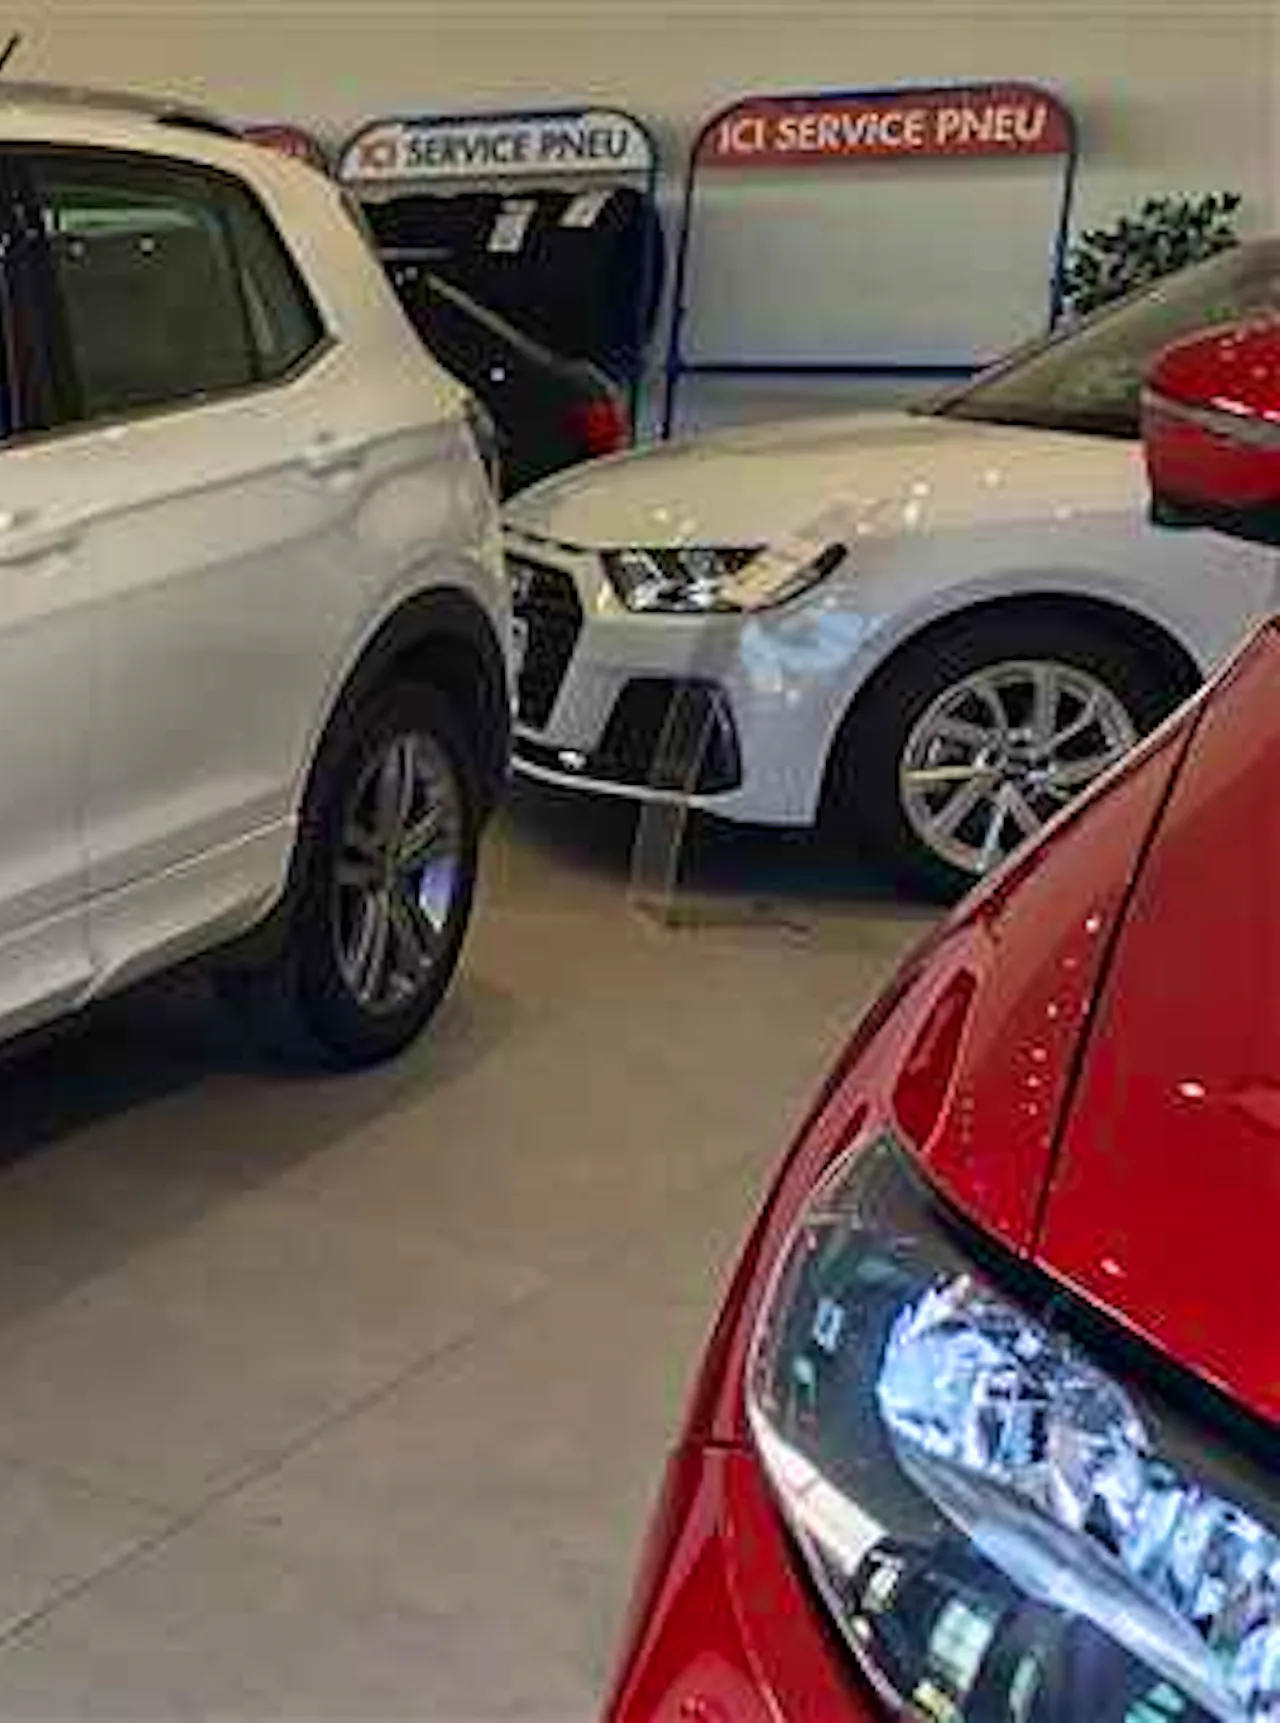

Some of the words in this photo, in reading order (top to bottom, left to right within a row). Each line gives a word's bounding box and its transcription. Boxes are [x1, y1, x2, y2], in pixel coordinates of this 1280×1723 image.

[357, 138, 396, 165] ICI
[540, 127, 627, 160] PNEU
[717, 115, 765, 152] ICI
[937, 103, 1047, 143] PNEU
